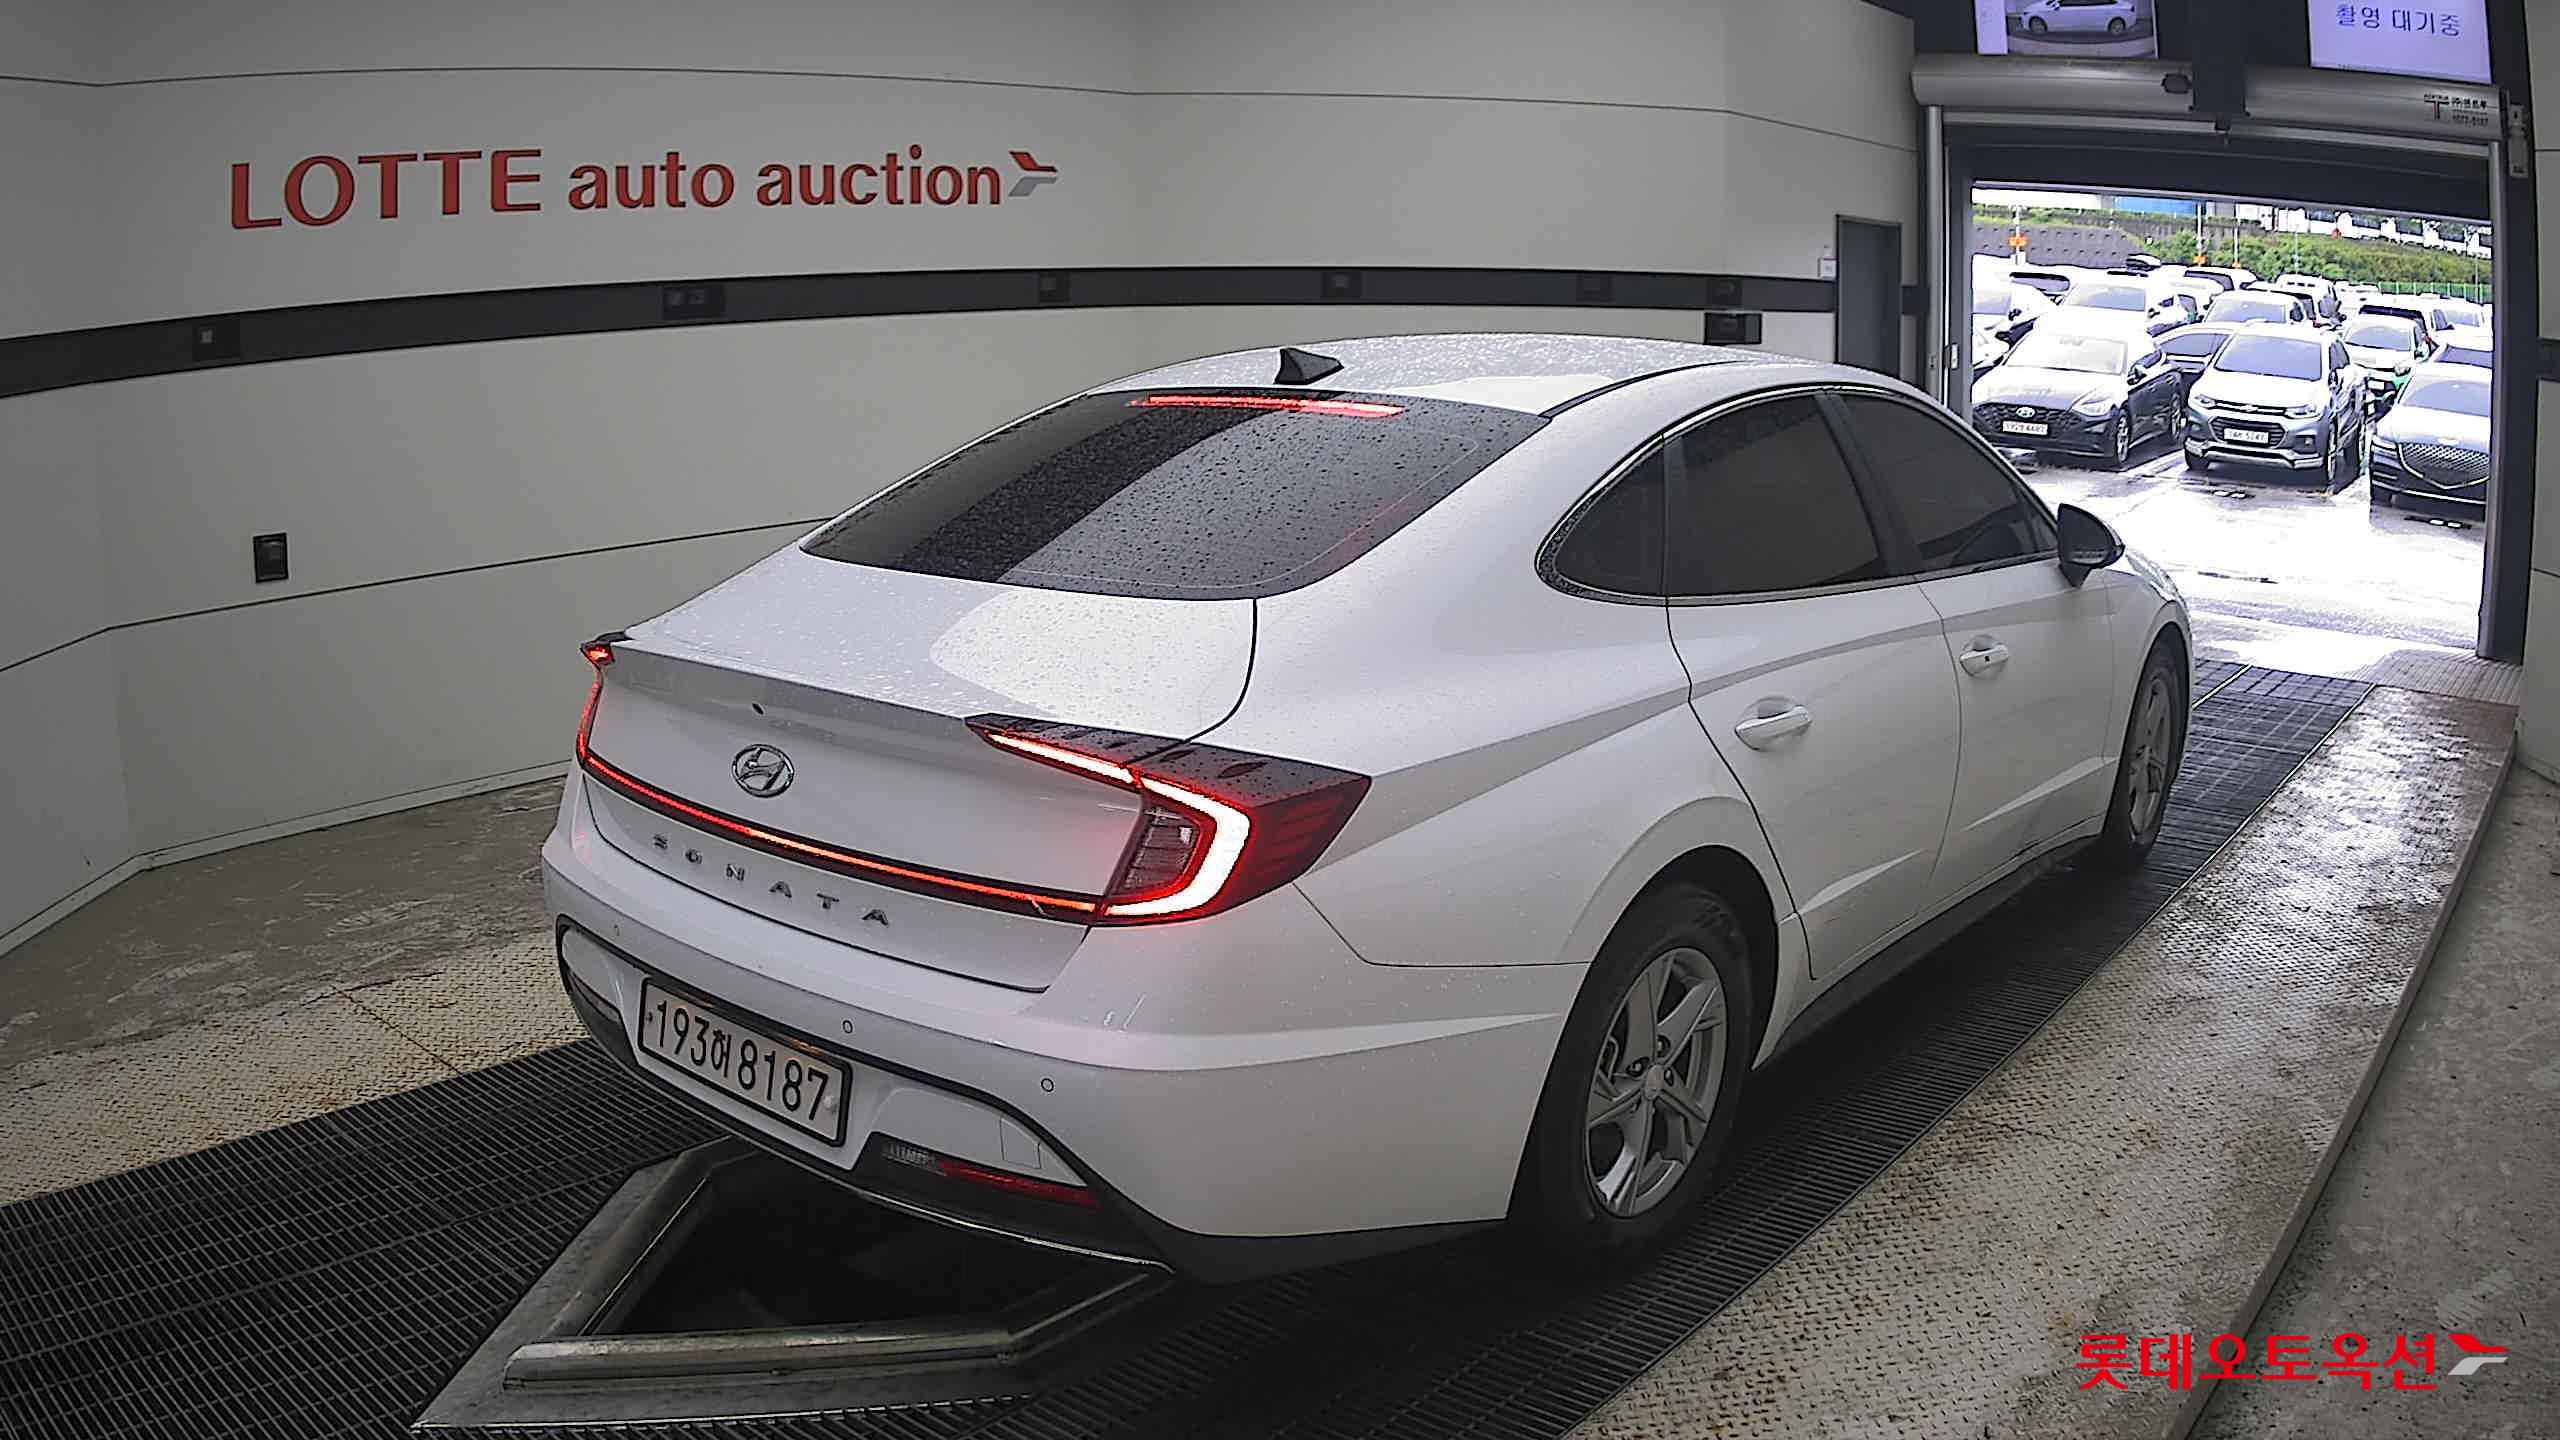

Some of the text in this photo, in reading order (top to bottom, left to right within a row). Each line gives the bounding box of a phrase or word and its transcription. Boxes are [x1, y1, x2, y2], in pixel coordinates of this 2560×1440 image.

[2336, 4, 2460, 37] 촬영 대기중
[231, 145, 1001, 229] LOTTE auto auction
[652, 832, 890, 928] SONATA
